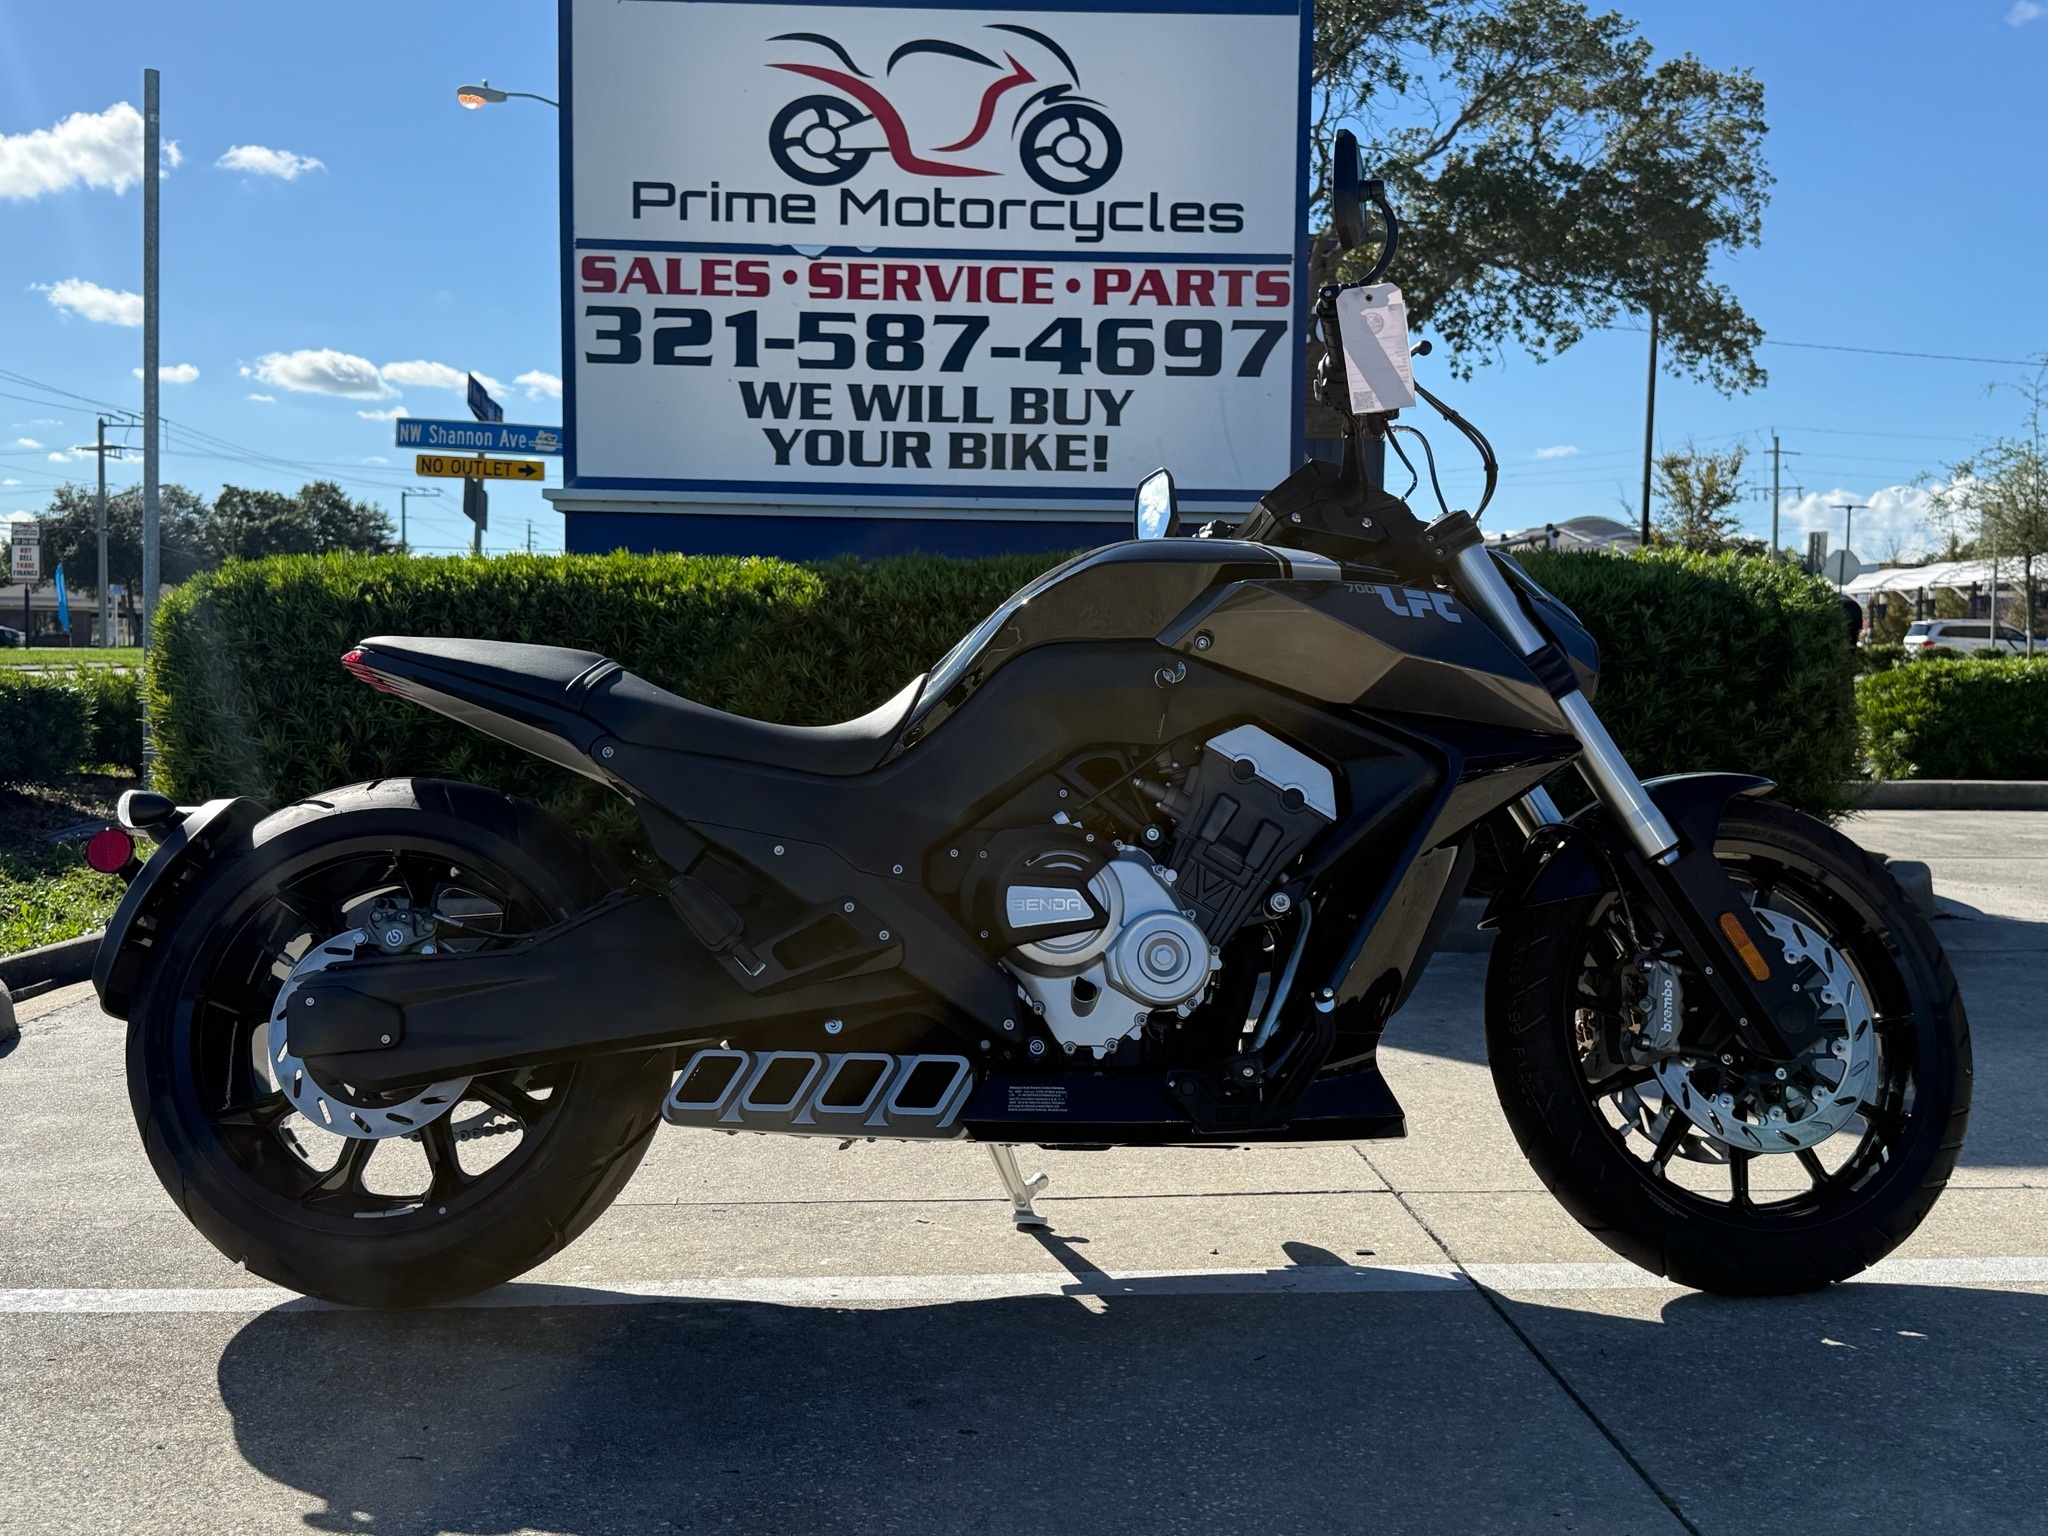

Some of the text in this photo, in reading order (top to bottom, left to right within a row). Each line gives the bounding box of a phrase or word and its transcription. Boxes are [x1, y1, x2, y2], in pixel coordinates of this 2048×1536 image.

[632, 181, 1244, 243] Prime Motorcycles
[581, 256, 1291, 308] SALES SERVICE PARTS
[585, 306, 1289, 378] 321-587-4697
[738, 381, 1134, 427] WE WILL BUY
[399, 423, 527, 448] NW Shannon Ave
[762, 428, 1108, 473] YOUR BIKE!
[421, 457, 513, 477] NO OUTLET
[1343, 583, 1463, 624] 700 LFC
[1012, 898, 1082, 912] BENDA
[1661, 979, 1673, 1033] brembo
